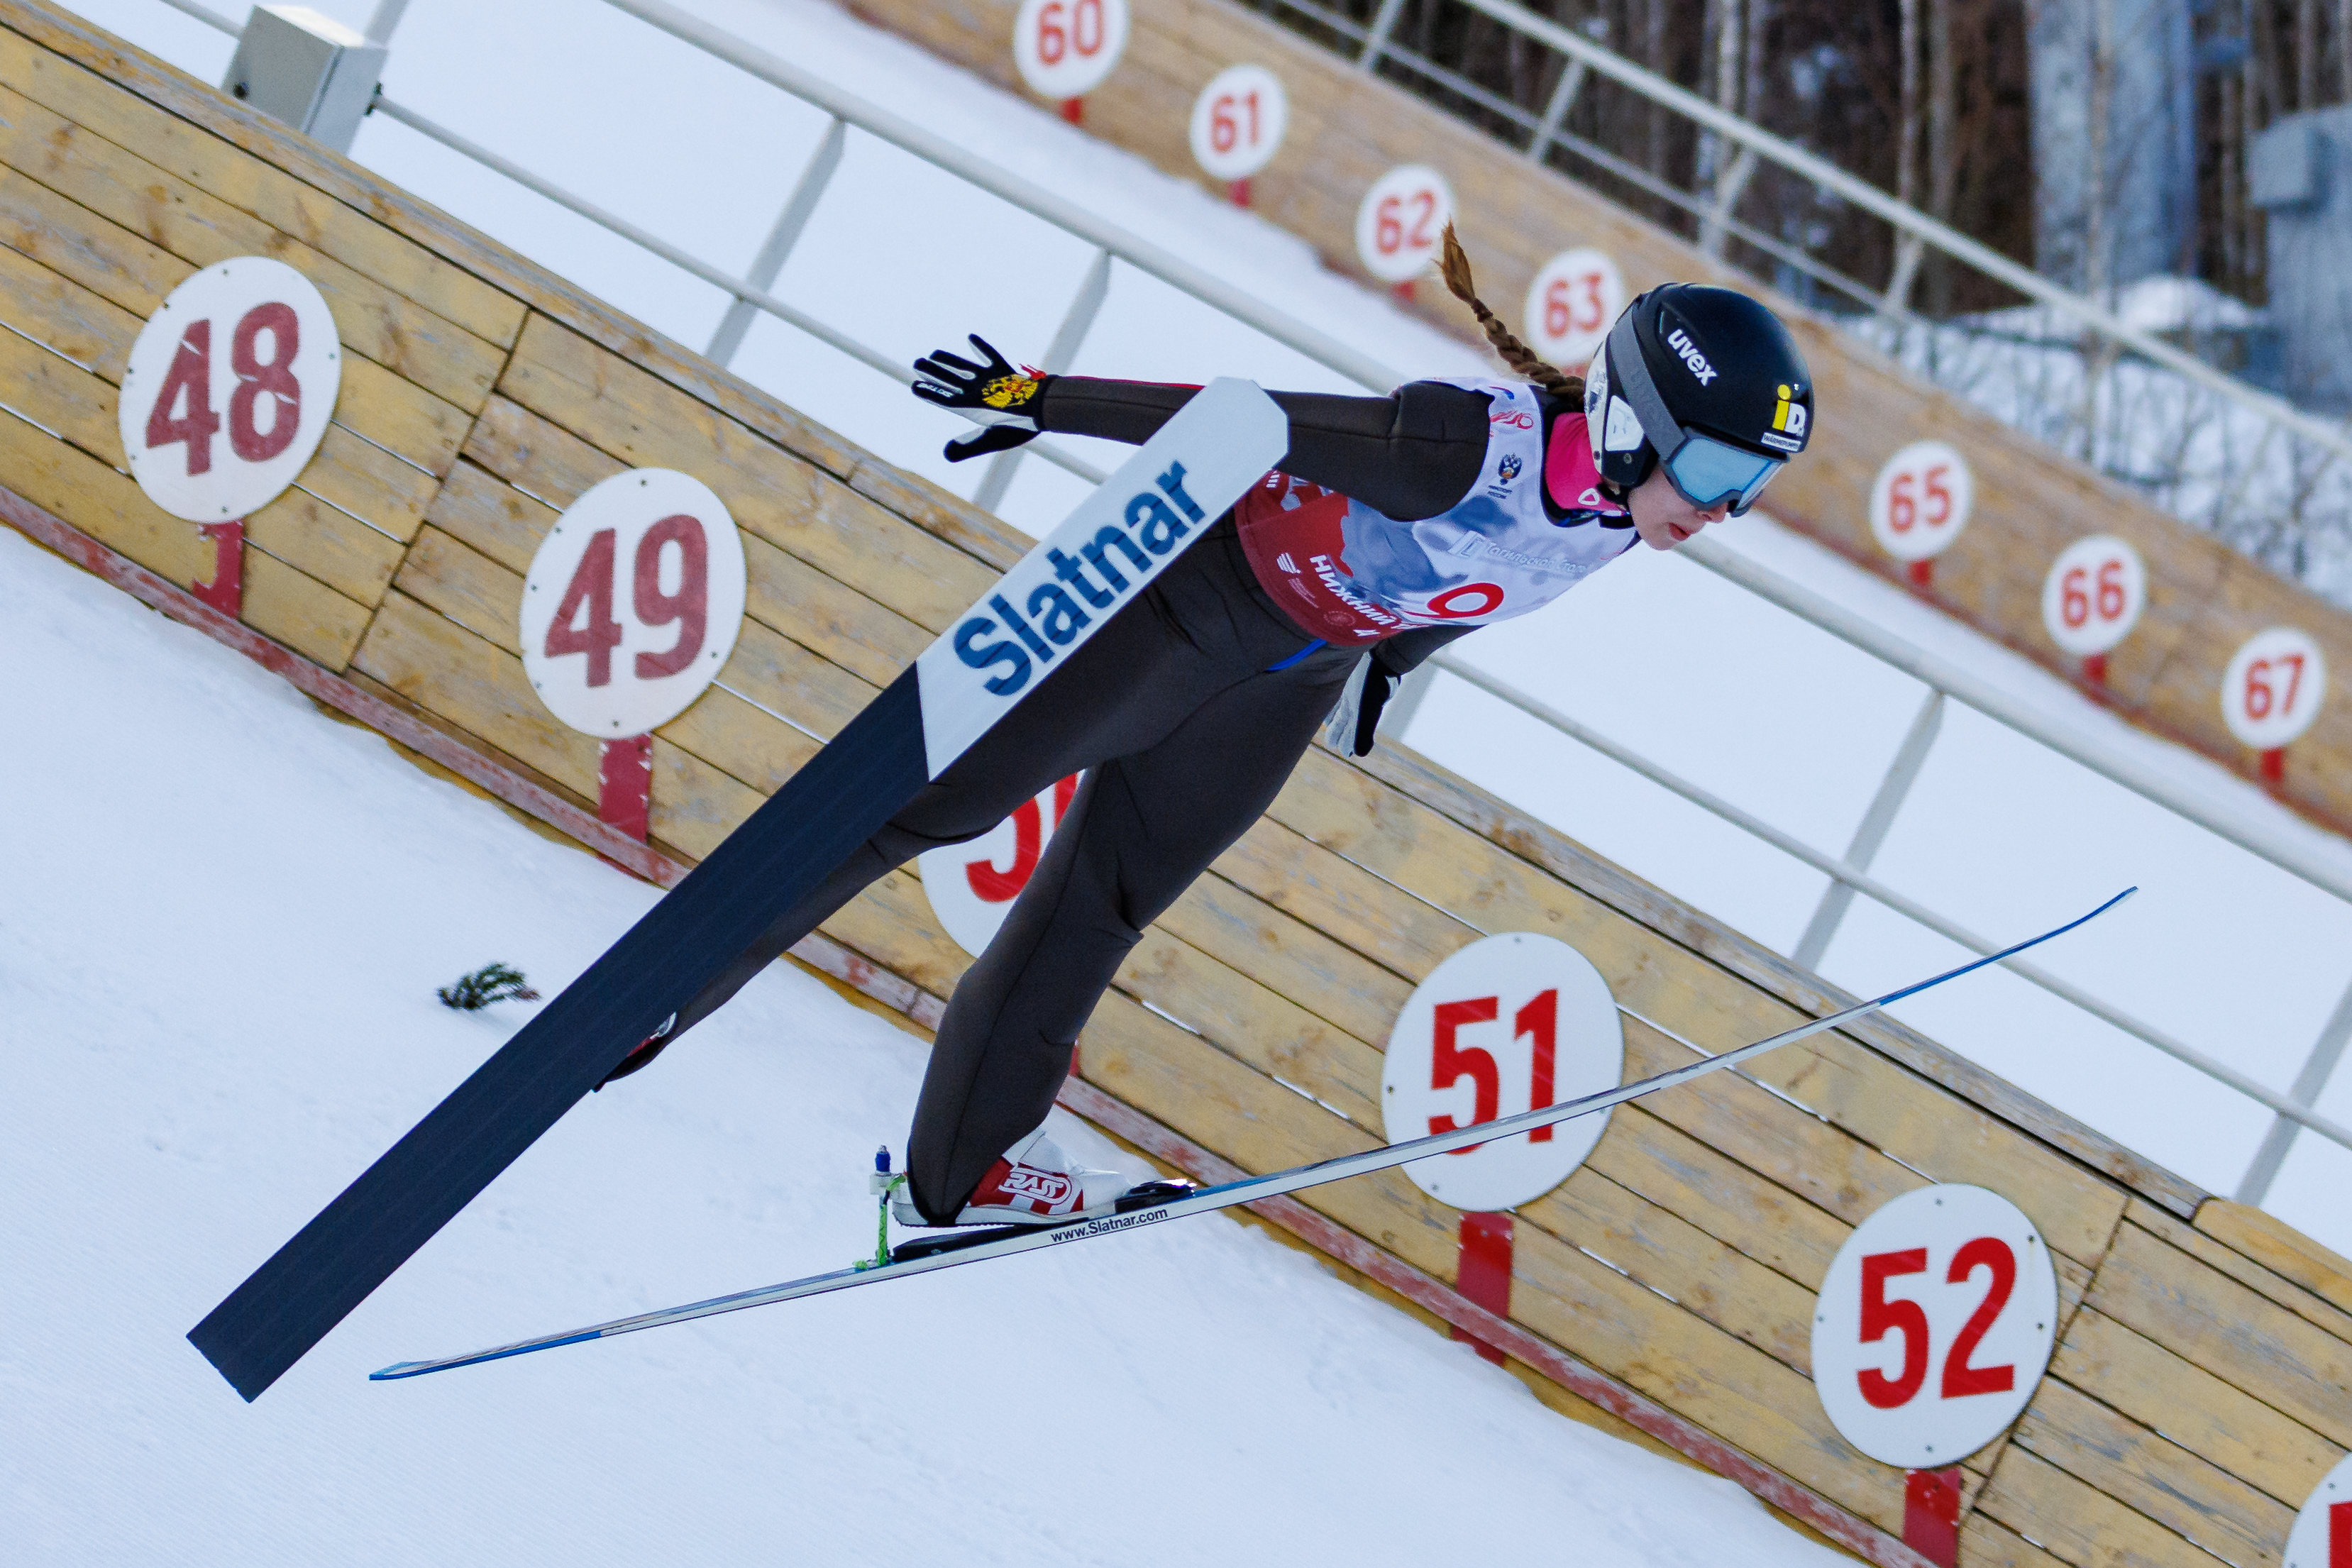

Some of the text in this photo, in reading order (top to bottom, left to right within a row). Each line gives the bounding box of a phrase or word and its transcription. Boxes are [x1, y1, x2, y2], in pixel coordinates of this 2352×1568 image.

[1037, 0, 1104, 66] 60
[1211, 92, 1260, 153] 61
[1376, 190, 1436, 256] 62
[1544, 272, 1603, 338] 63
[146, 302, 301, 476] 48
[1667, 328, 1718, 387] uvex
[1888, 466, 1952, 534] 65
[545, 514, 708, 687] 49
[953, 460, 1206, 698] Slatnar
[2061, 559, 2126, 630] 66
[2243, 653, 2306, 722] 67
[1428, 987, 1559, 1156] 51
[1050, 1208, 1169, 1243] www.Slatnar.com
[1855, 1235, 2017, 1410] 52
